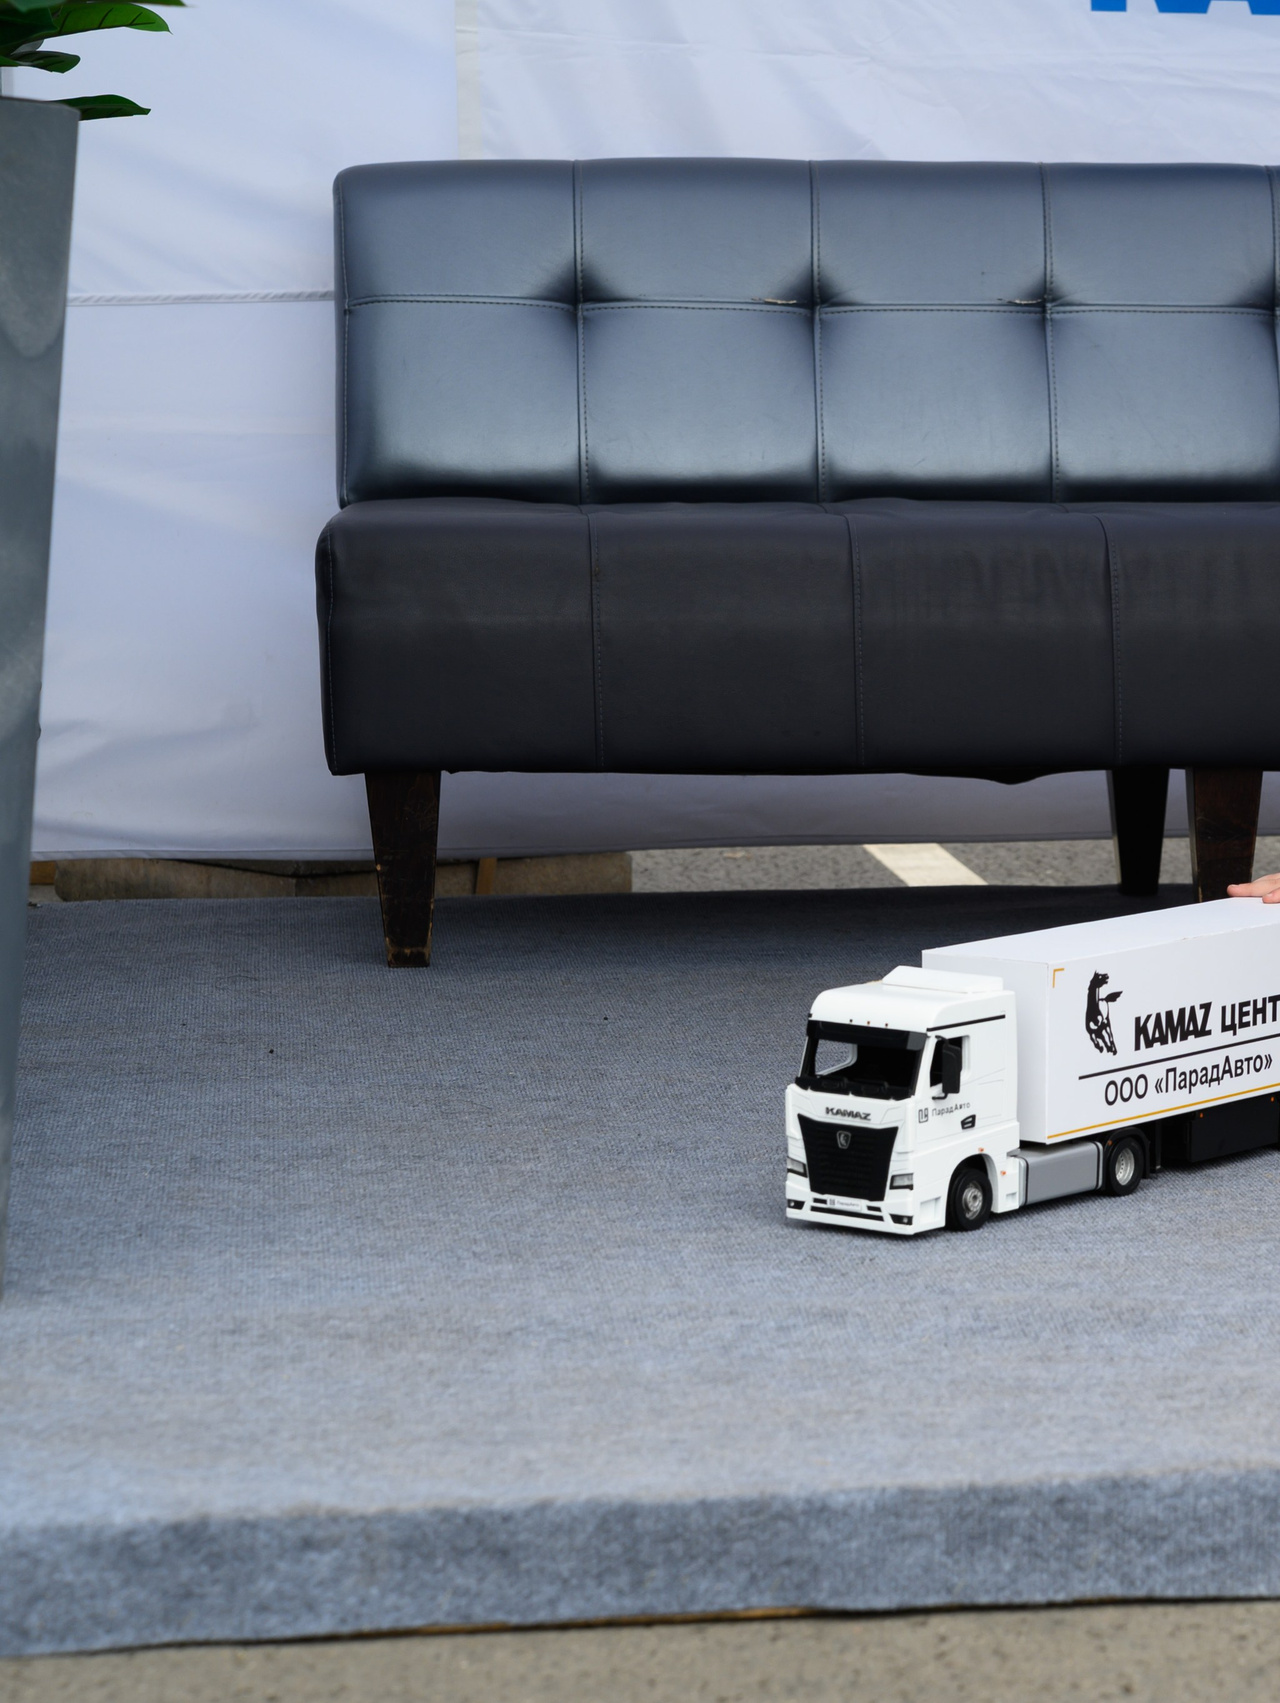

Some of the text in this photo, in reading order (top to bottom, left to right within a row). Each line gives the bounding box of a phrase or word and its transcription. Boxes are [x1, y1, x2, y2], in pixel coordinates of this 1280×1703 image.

[1134, 1001, 1212, 1051] KAMAZ
[1104, 1053, 1273, 1106] ООО «ПарадАвто»
[825, 1106, 871, 1121] KAMAZ
